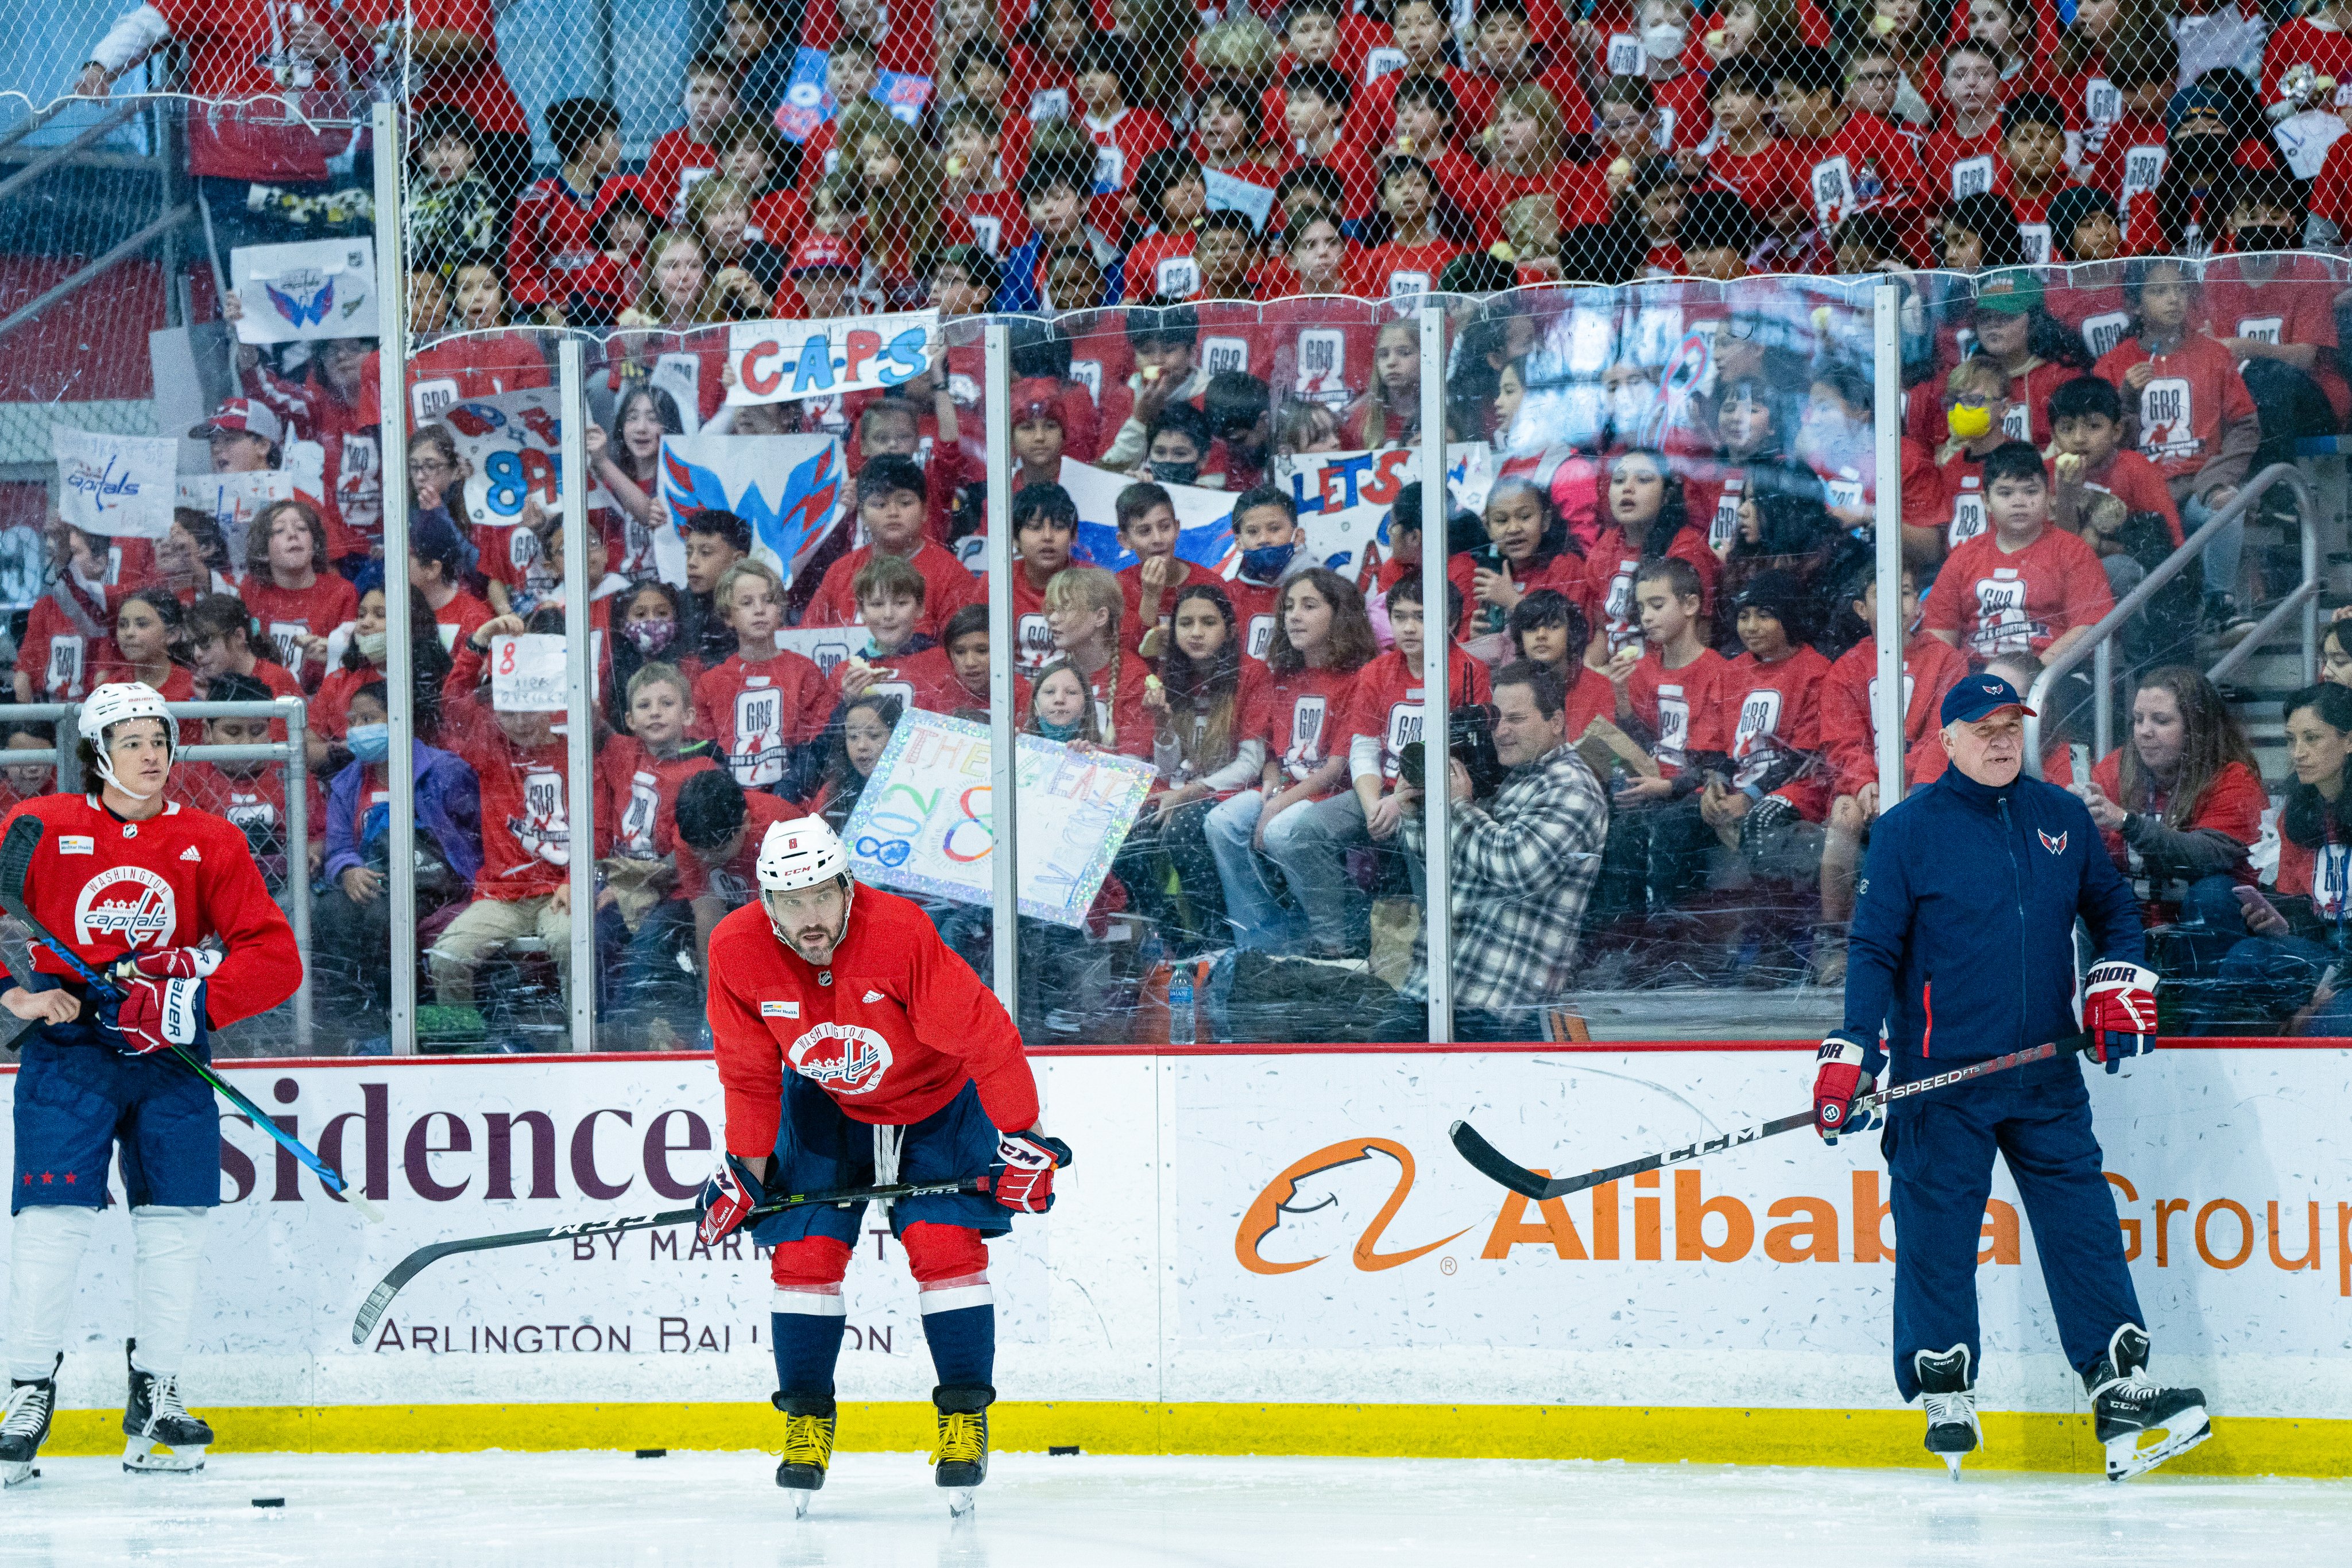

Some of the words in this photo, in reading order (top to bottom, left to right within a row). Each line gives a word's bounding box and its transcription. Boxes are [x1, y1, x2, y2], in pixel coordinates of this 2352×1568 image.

[1209, 347, 1240, 375] GR8
[1306, 340, 1334, 370] GR8
[2149, 389, 2180, 420] GR8
[1291, 450, 1412, 516] LETS
[1715, 505, 1740, 540] GR
[499, 642, 516, 675] 8
[746, 699, 772, 732] GR8
[1741, 703, 1768, 733] GR8
[905, 727, 992, 777] THE
[788, 838, 798, 849] 8
[87, 868, 169, 896] WASHINGTON
[784, 865, 811, 877] CCM
[83, 892, 168, 943] capitals
[2084, 966, 2137, 989] RRIOR
[1855, 1070, 1963, 1112] JETSPEED
[216, 1078, 711, 1203] sidence
[1000, 1141, 1045, 1167] CM
[1661, 1124, 1763, 1166] CCM
[574, 1230, 626, 1260] BY
[375, 1318, 631, 1353] ARLINGTON
[660, 1317, 891, 1354] BALLON
[1933, 1358, 1955, 1366] CCM
[2110, 1400, 2142, 1412] CCM
